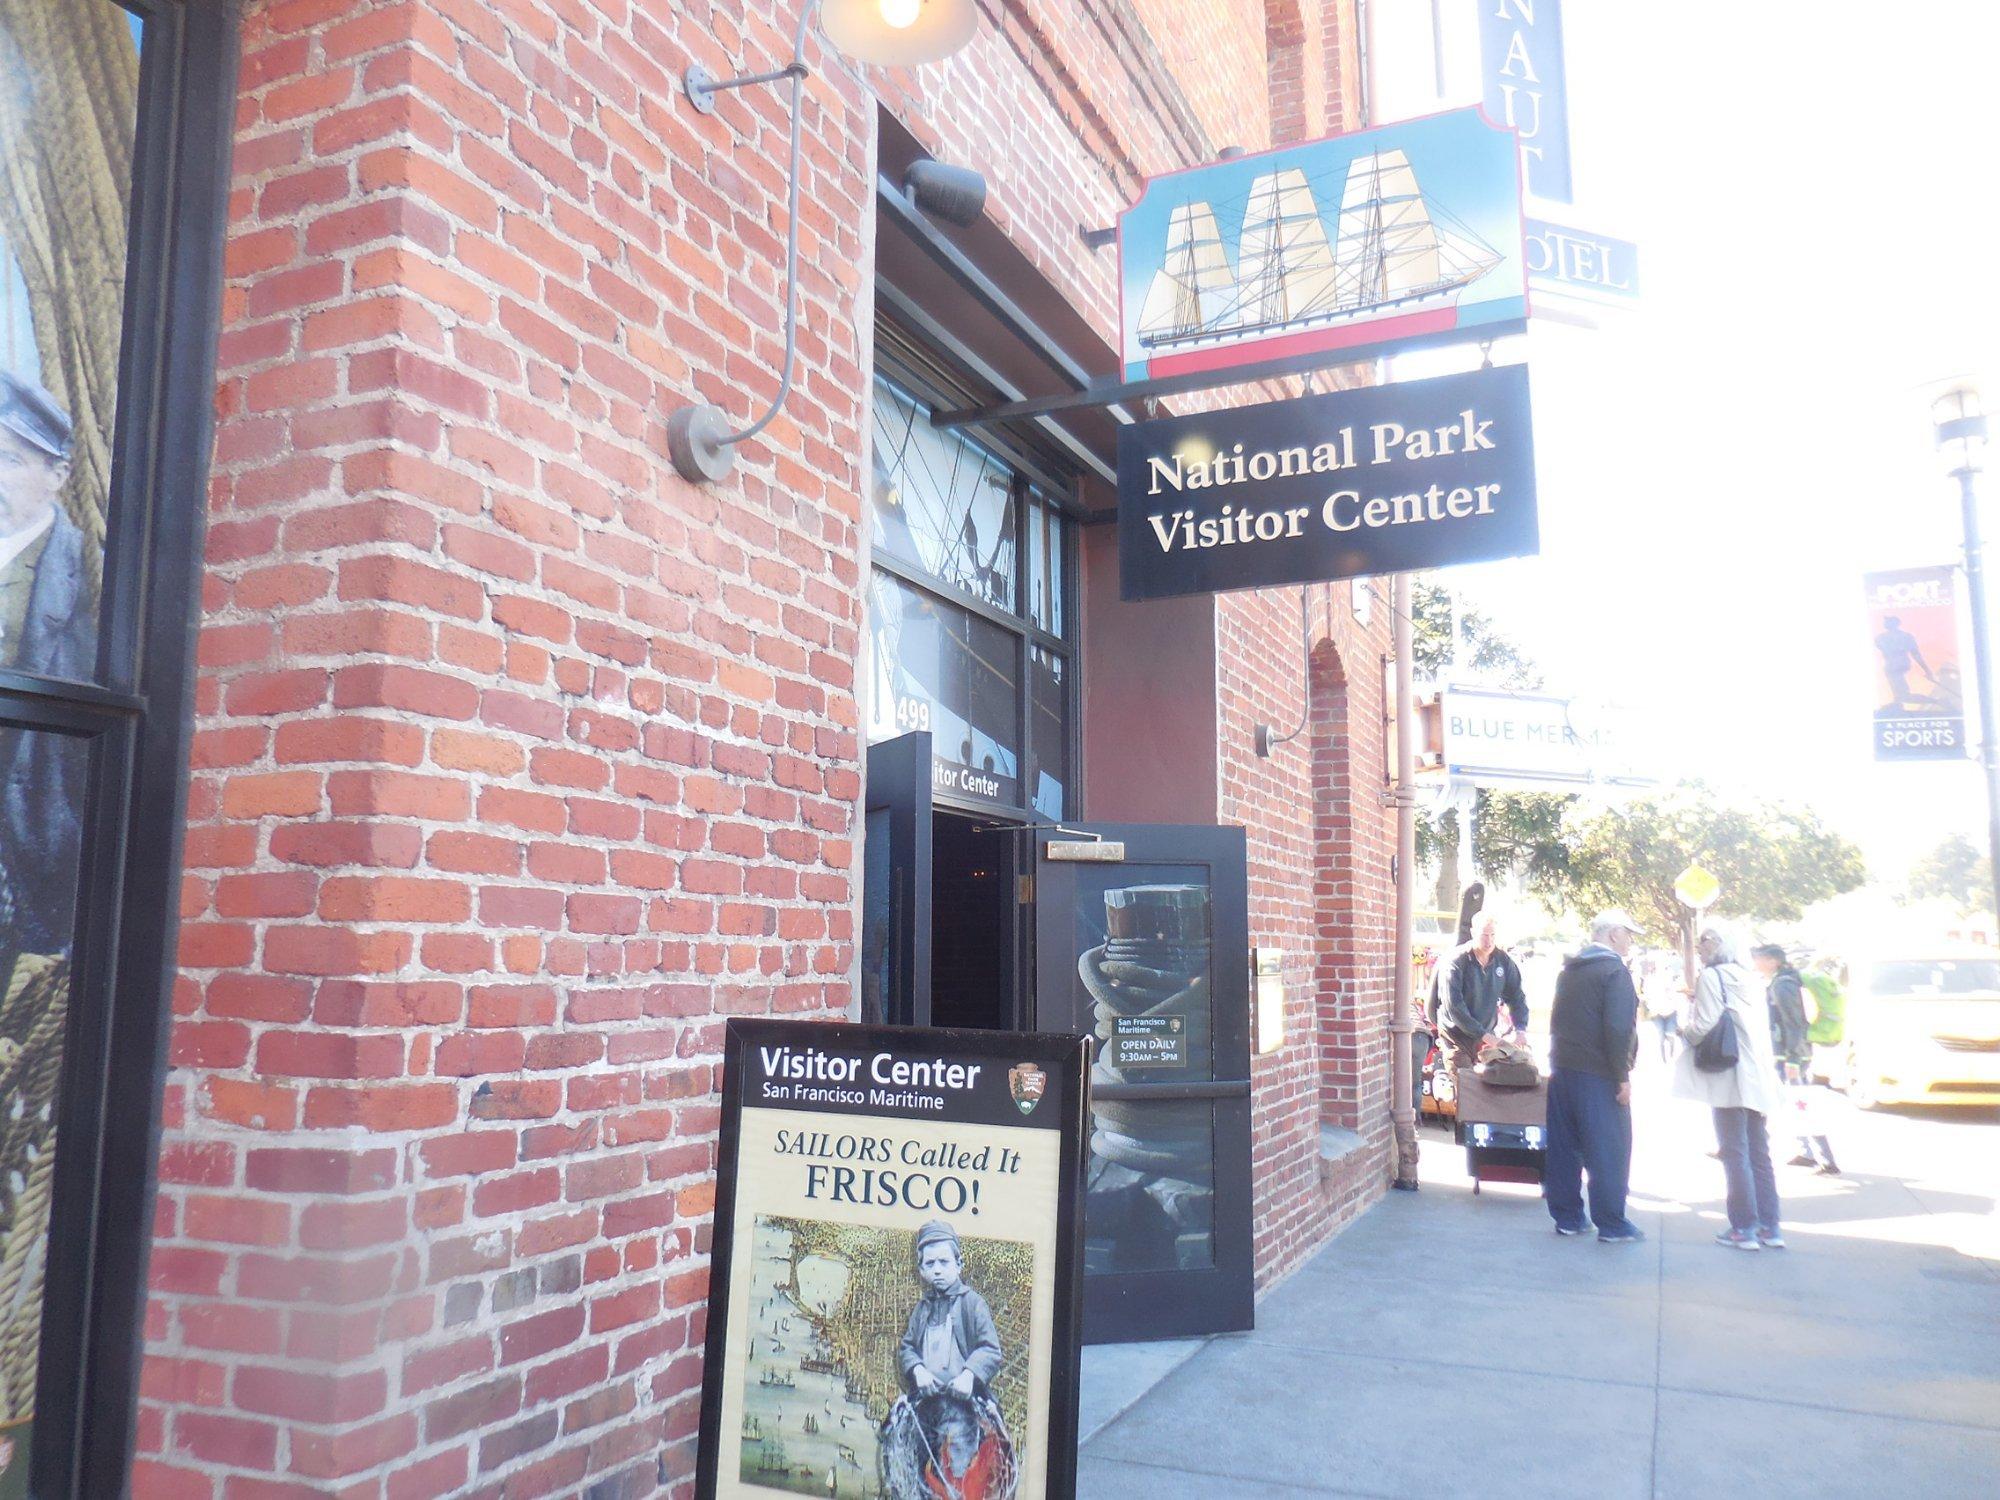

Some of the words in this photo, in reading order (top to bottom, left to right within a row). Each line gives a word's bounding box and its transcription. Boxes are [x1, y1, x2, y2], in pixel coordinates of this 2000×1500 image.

[1525, 230, 1629, 290] OTEL
[1147, 426, 1357, 495] National
[1370, 409, 1496, 466] Park
[1147, 504, 1309, 553] Visitor
[1322, 482, 1501, 532] Center
[896, 696, 930, 731] 499
[1450, 715, 1515, 741] BLUE
[1882, 729, 1955, 747] SPORTS
[961, 769, 999, 797] Center
[1118, 1018, 1132, 1026] San
[1133, 1018, 1166, 1026] Francisco
[1118, 1026, 1151, 1034] Maritime
[1119, 1052, 1152, 1062] 9:30AM
[1160, 1051, 1178, 1061] 5PM
[1121, 1040, 1147, 1050] OPEN
[1149, 1039, 1177, 1050] DAILY
[760, 1046, 862, 1082] Visitor
[870, 1051, 981, 1089] Center
[762, 1081, 790, 1100] San
[794, 1084, 865, 1105] Francisco
[869, 1088, 945, 1111] Maritime
[774, 1129, 893, 1163] SAILORS
[900, 1139, 991, 1173] Called
[997, 1147, 1021, 1174] It
[804, 1163, 980, 1216] FRISCO!
